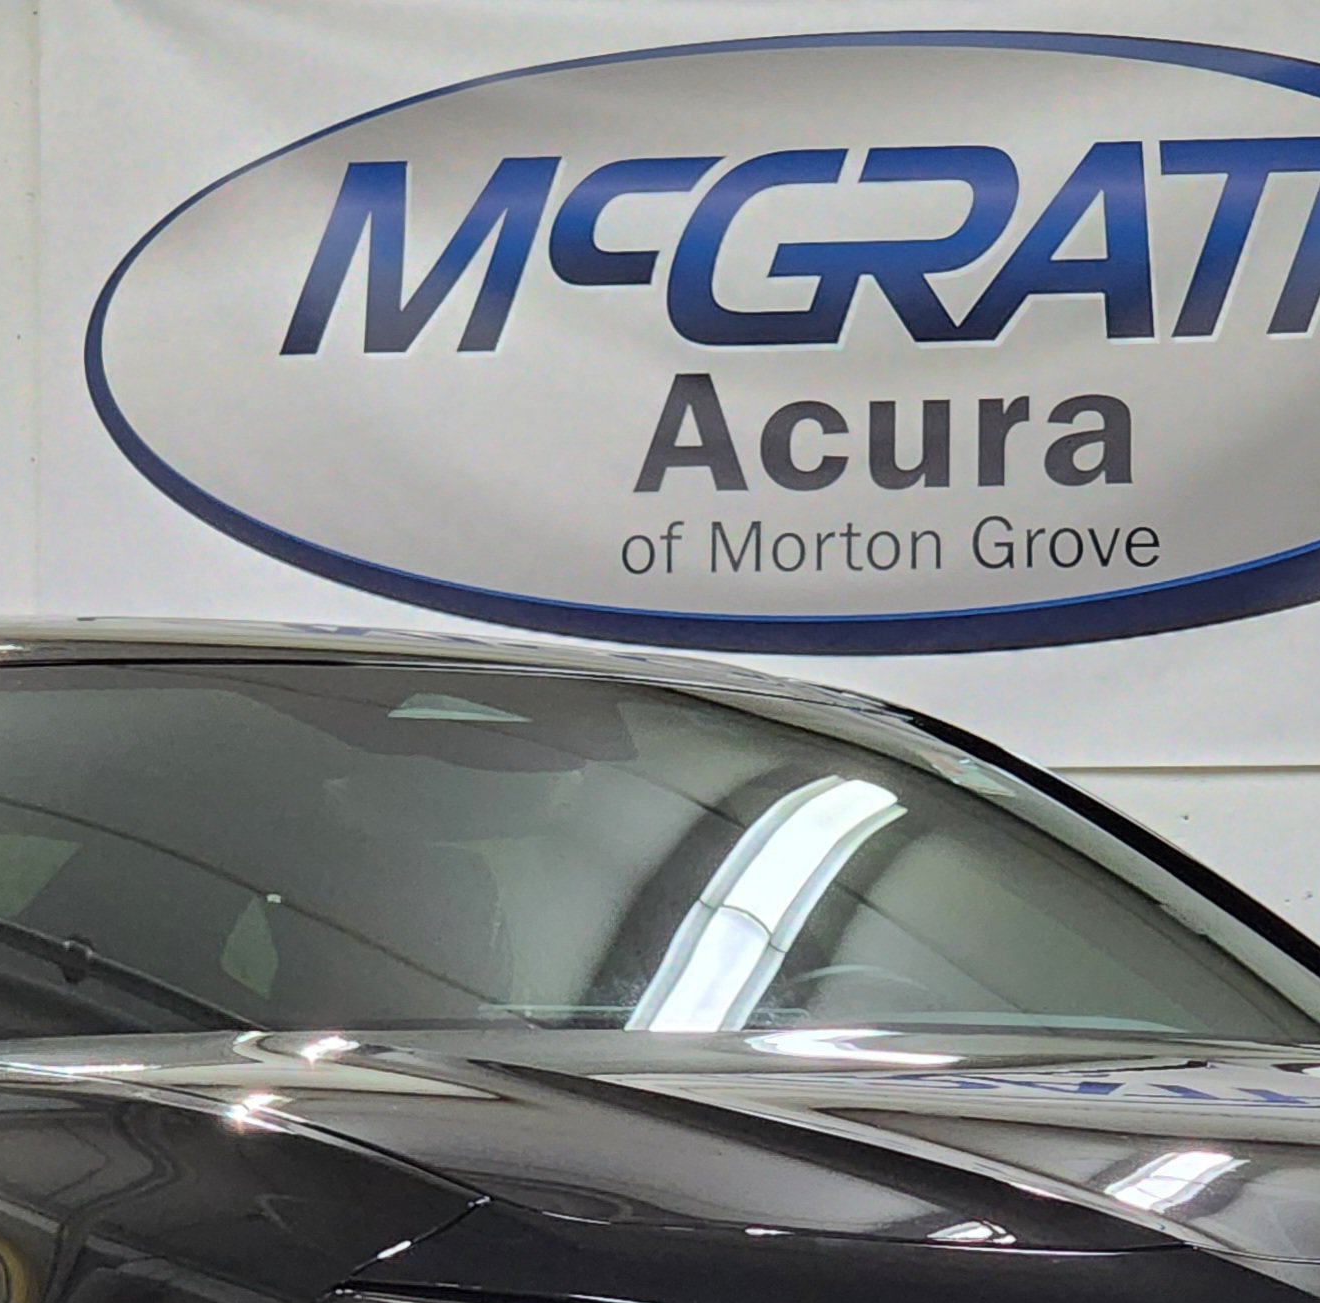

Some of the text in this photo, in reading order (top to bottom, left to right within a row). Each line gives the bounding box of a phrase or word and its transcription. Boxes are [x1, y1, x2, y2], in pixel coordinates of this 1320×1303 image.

[633, 372, 1133, 493] Acura
[621, 515, 1161, 575] of Morton Grove
